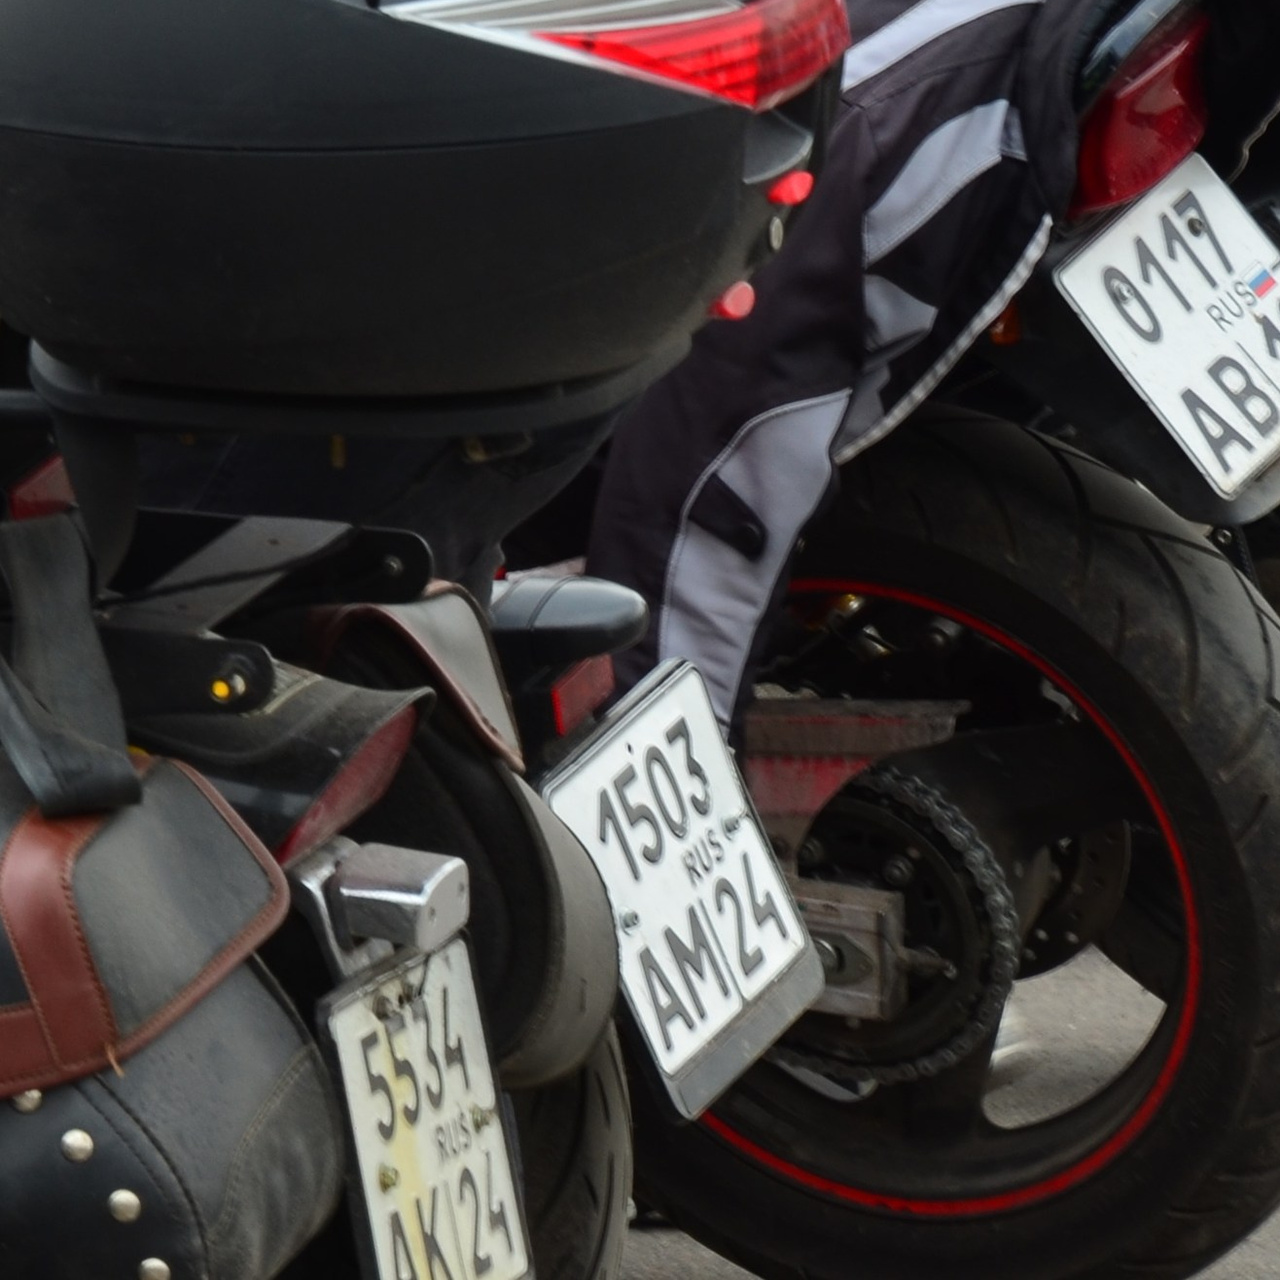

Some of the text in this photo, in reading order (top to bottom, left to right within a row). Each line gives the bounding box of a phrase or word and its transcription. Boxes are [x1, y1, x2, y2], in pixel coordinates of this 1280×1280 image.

[1102, 189, 1234, 345] 0117
[1206, 281, 1258, 332] RUS
[598, 717, 711, 881] 1503
[683, 828, 724, 888] RUS
